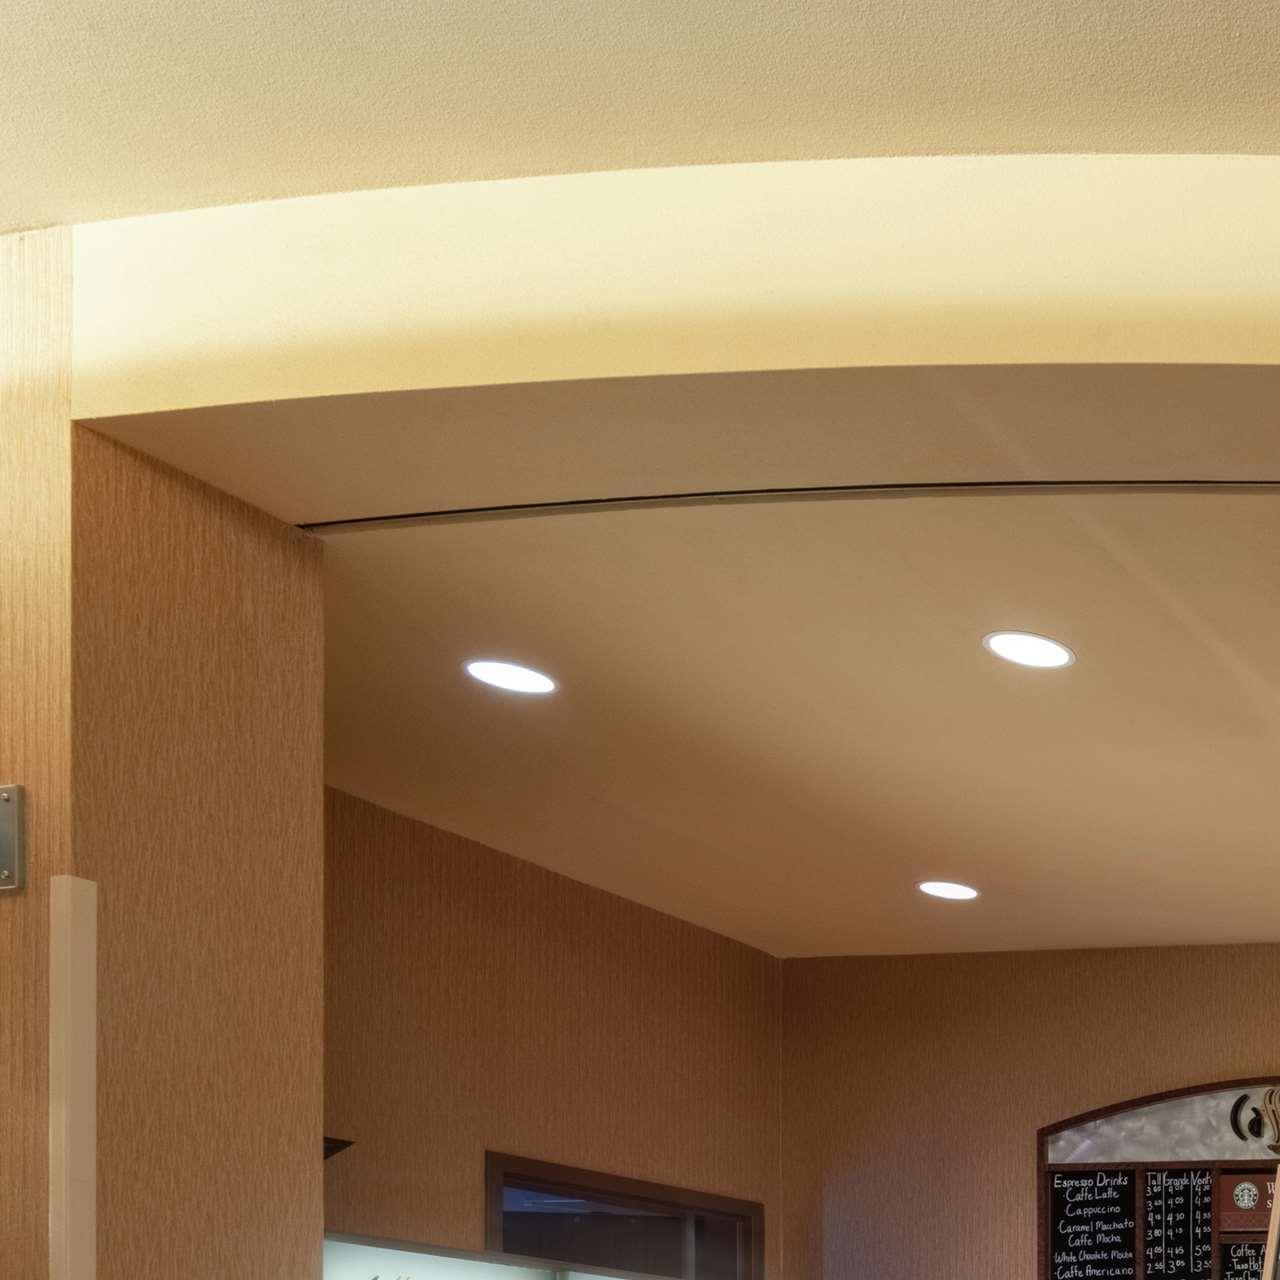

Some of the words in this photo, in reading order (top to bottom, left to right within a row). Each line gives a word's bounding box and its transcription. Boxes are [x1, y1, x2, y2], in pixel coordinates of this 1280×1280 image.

[1054, 1173, 1094, 1188] Espresso
[1096, 1172, 1128, 1187] Drinks
[1146, 1172, 1162, 1186] Tall
[1164, 1171, 1190, 1187] Grande
[1095, 1187, 1119, 1200] Latte
[1065, 1204, 1120, 1217] Cappuccino
[1059, 1220, 1093, 1234] Caramel
[1096, 1233, 1122, 1244] Mocha
[1055, 1251, 1076, 1264] White
[1230, 1245, 1257, 1257] Coffee
[1085, 1264, 1134, 1277] Americano
